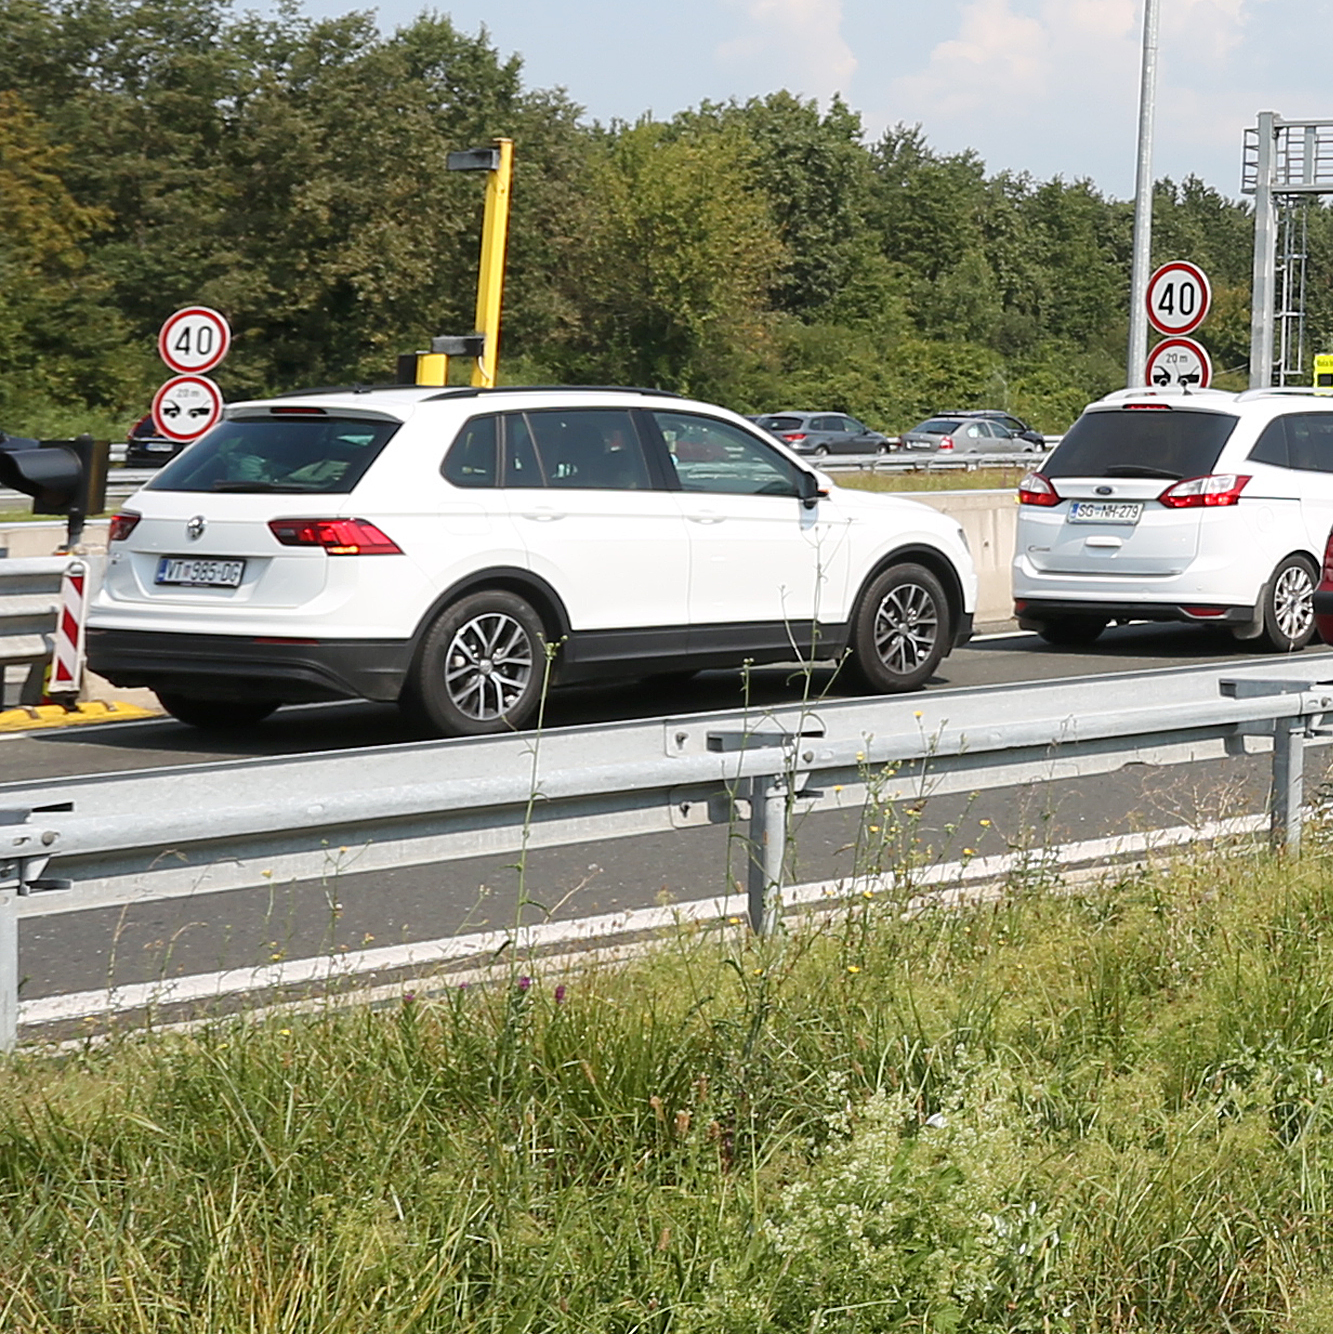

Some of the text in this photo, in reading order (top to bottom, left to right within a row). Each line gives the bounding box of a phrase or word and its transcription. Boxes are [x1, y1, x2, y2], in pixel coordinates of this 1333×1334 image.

[1158, 282, 1195, 316] 40
[174, 326, 213, 355] 40
[1166, 353, 1188, 364] 20 m
[1077, 504, 1094, 517] SG
[167, 561, 184, 579] VT
